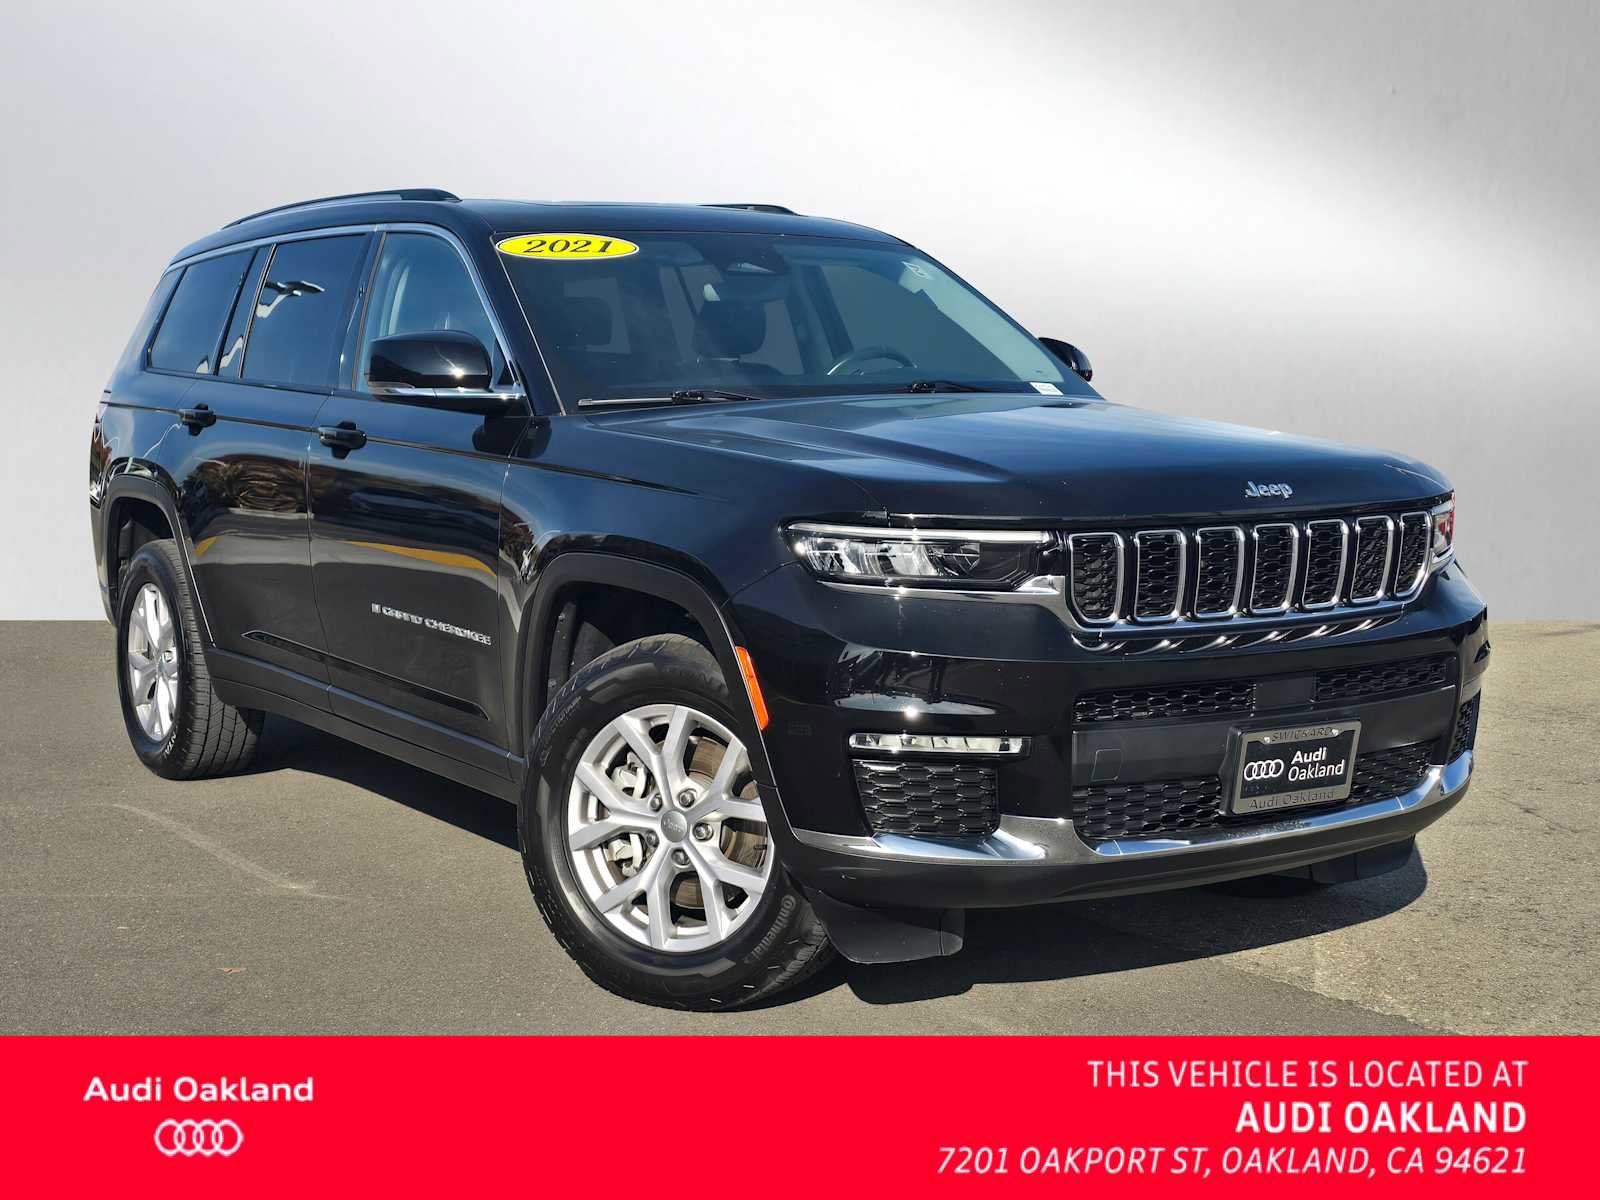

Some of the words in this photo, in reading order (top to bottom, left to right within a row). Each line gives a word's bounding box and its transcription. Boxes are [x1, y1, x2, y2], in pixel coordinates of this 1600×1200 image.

[523, 239, 613, 253] 2021
[1245, 480, 1293, 499] Jeep
[382, 606, 424, 625] GRAND
[424, 618, 492, 646] CHEROKEE
[1291, 747, 1327, 765] Audi
[1288, 759, 1345, 781] Oakland
[1250, 795, 1279, 809] Audi
[1283, 790, 1335, 805] Oakland
